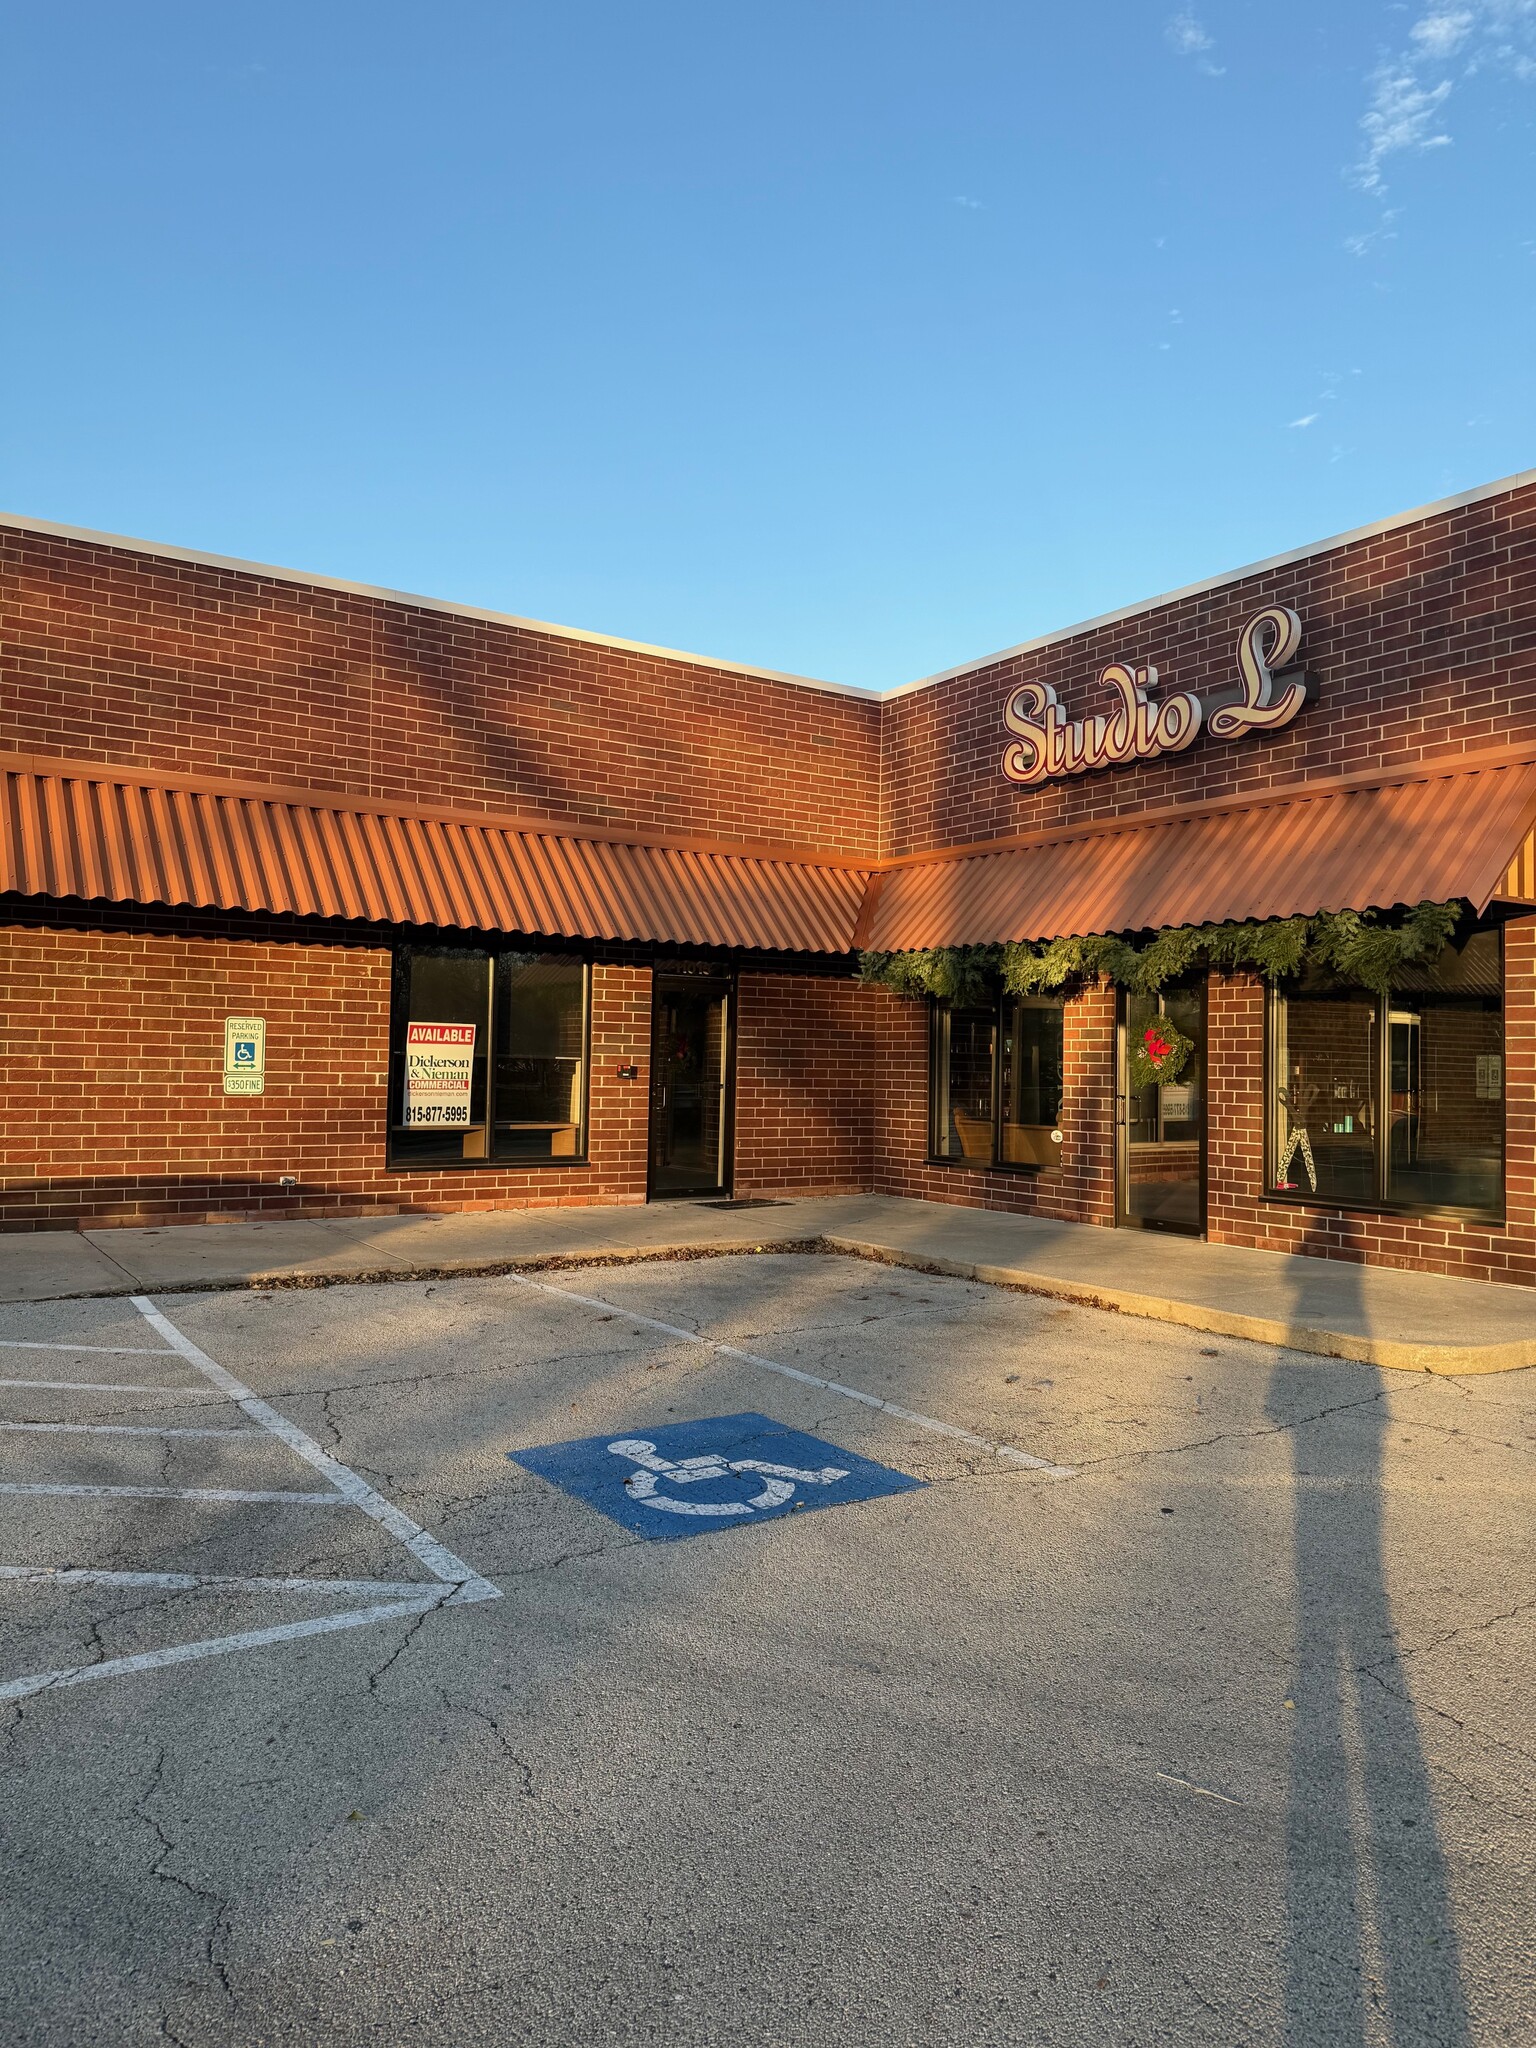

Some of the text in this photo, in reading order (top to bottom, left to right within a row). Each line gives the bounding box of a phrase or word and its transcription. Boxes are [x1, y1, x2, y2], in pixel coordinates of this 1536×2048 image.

[1001, 605, 1306, 785] Studio L
[229, 1022, 262, 1031] RESERVED
[231, 1032, 259, 1040] PARKING
[410, 1027, 472, 1042] AVAILABLE
[409, 1055, 470, 1068] Dickerson
[410, 1068, 469, 1079] & Nieman
[228, 1079, 261, 1090] $350 FINE
[409, 1080, 467, 1089] COMMERCIAL
[405, 1106, 468, 1122] 815-877-5995
